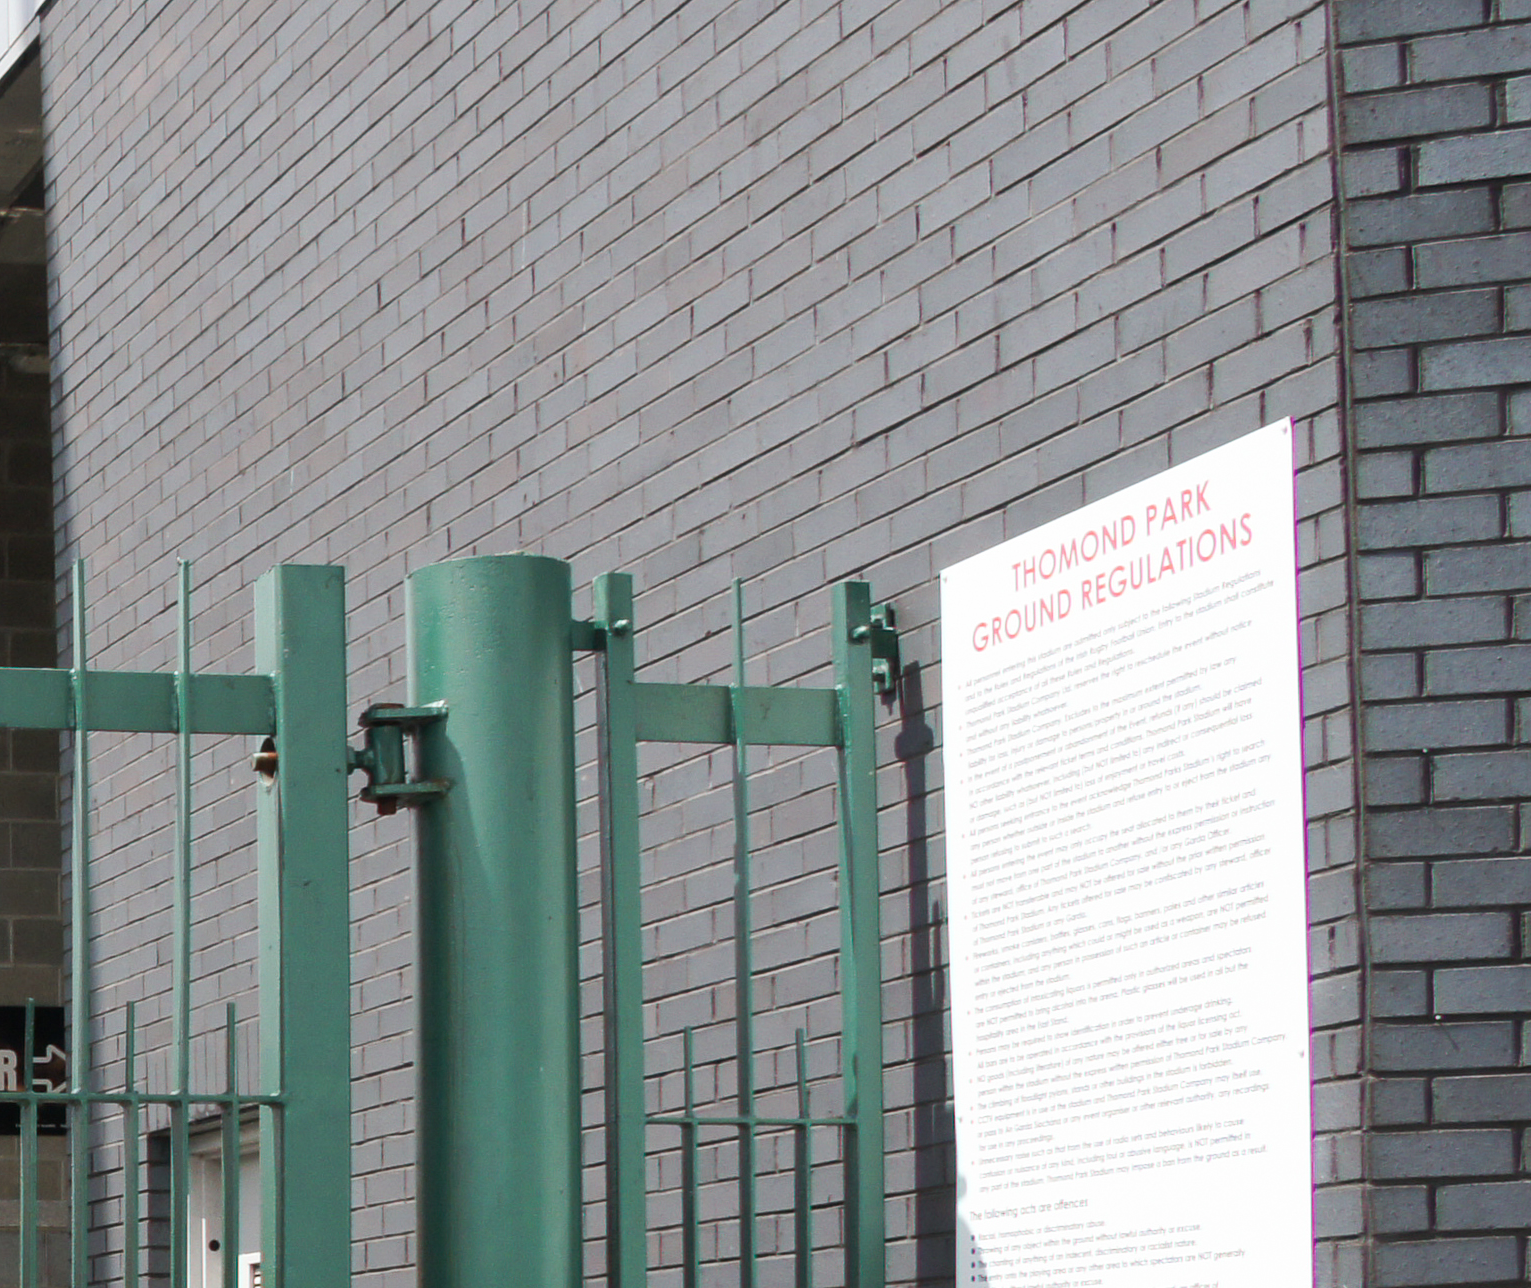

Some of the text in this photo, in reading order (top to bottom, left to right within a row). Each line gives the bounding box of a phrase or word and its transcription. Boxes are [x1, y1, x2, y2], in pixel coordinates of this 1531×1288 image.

[972, 512, 1253, 652] GROUND REGULATIONS
[1011, 480, 1211, 592] THOMOND PARK
[971, 1196, 1088, 1222] The following acts are offences
